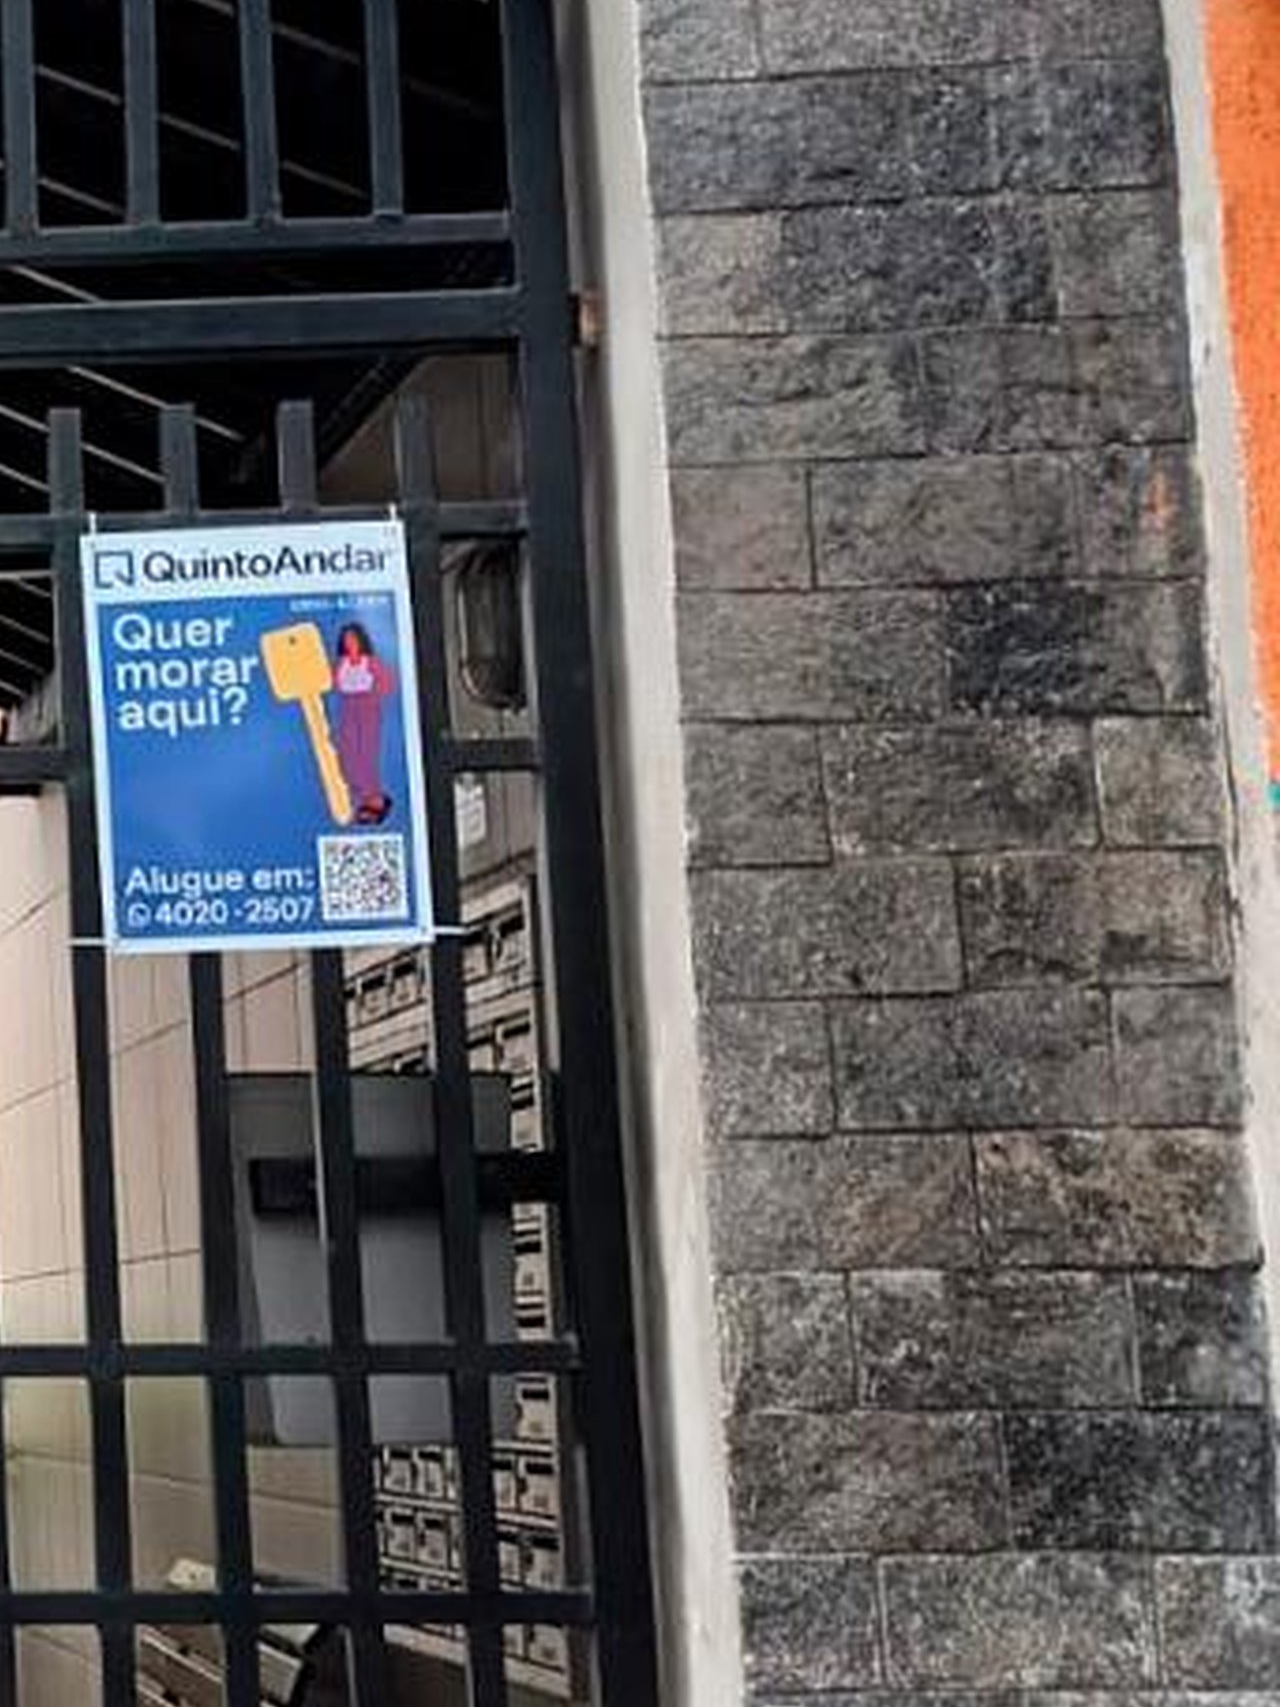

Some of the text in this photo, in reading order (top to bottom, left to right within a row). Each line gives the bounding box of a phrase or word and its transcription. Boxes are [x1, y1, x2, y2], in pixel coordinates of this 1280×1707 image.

[143, 544, 385, 583] QuintoAndar
[113, 612, 233, 652] Quer
[115, 654, 259, 691] morar
[118, 685, 248, 738] aqui?
[124, 865, 316, 900] Alugue em:
